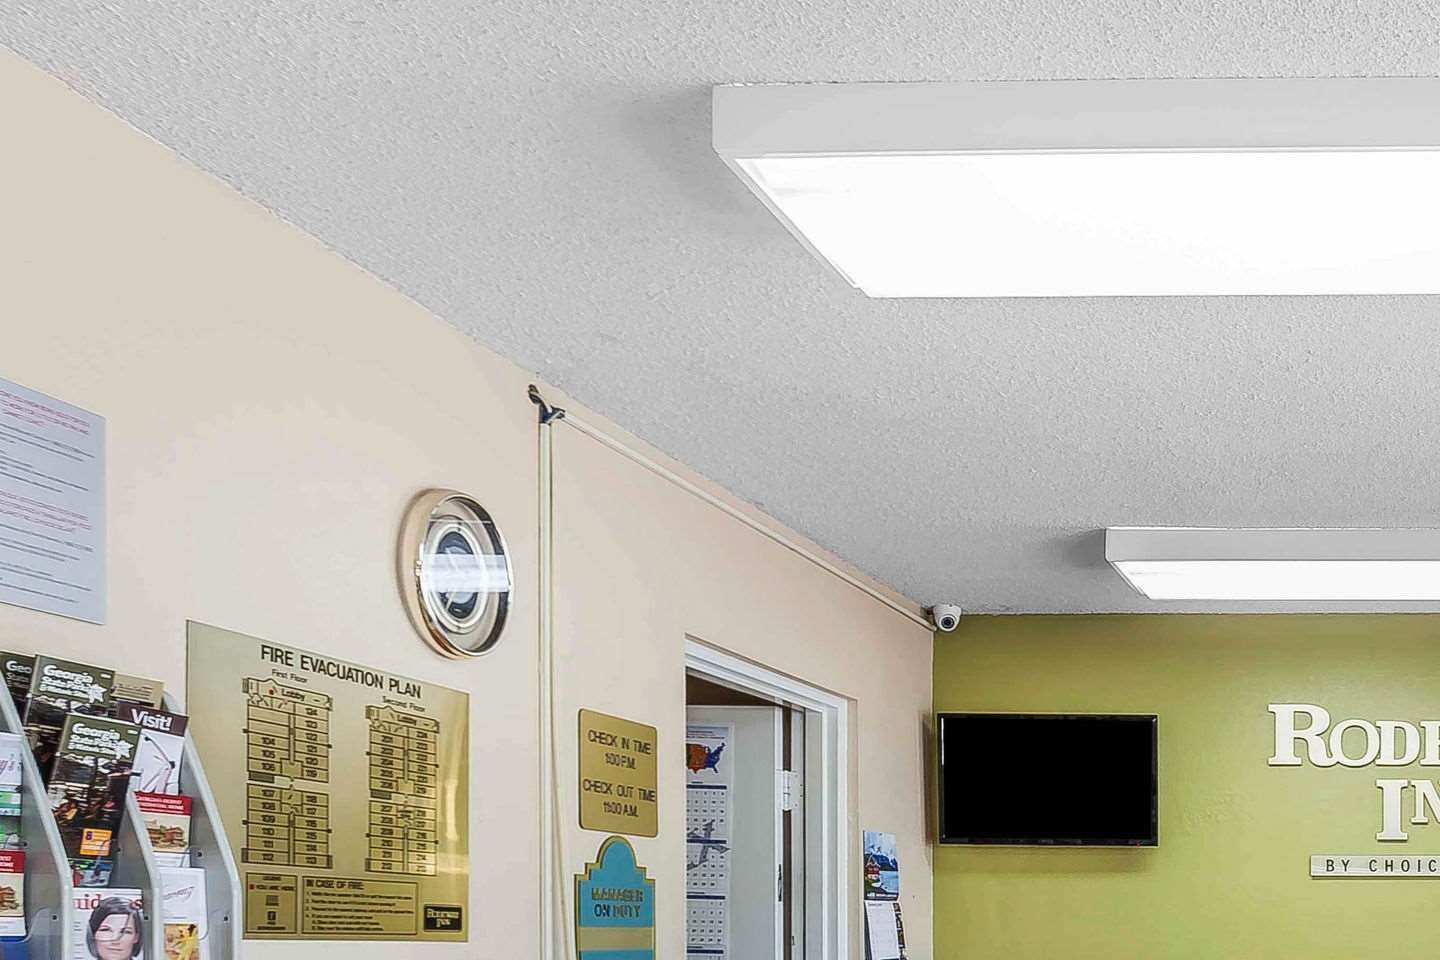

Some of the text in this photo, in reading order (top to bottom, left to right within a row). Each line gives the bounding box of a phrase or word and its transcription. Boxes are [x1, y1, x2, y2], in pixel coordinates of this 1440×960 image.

[43, 664, 94, 684] Georgia
[261, 644, 421, 699] FIRE EVACUATION PLAN
[271, 668, 308, 683] First Floor
[281, 688, 305, 701] Lobby
[131, 707, 173, 731] Visit!
[72, 723, 120, 742] Georgia
[588, 729, 651, 755] CHECK IN TIME
[583, 779, 656, 803] CHECK OUT TIME
[1325, 859, 1350, 872] BY
[594, 904, 641, 918] ON DUTY
